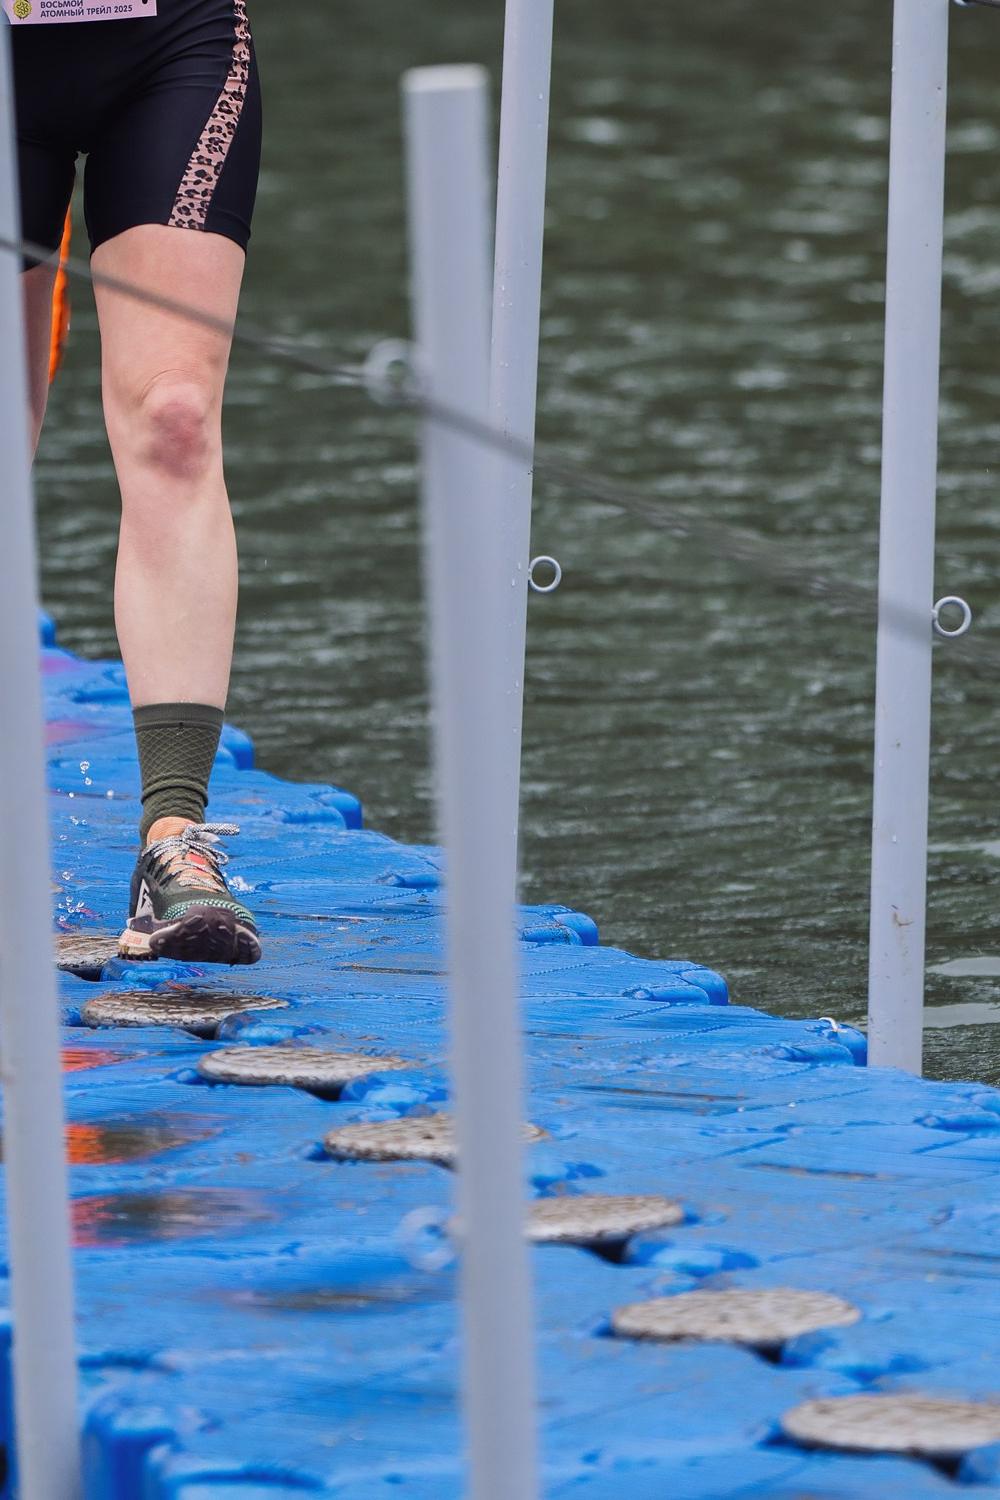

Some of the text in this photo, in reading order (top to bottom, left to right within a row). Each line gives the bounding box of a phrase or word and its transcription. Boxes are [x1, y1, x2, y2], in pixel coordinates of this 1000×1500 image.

[40, 4, 133, 18] АТОМНЫЙ ТРЕЙЛ 2025
